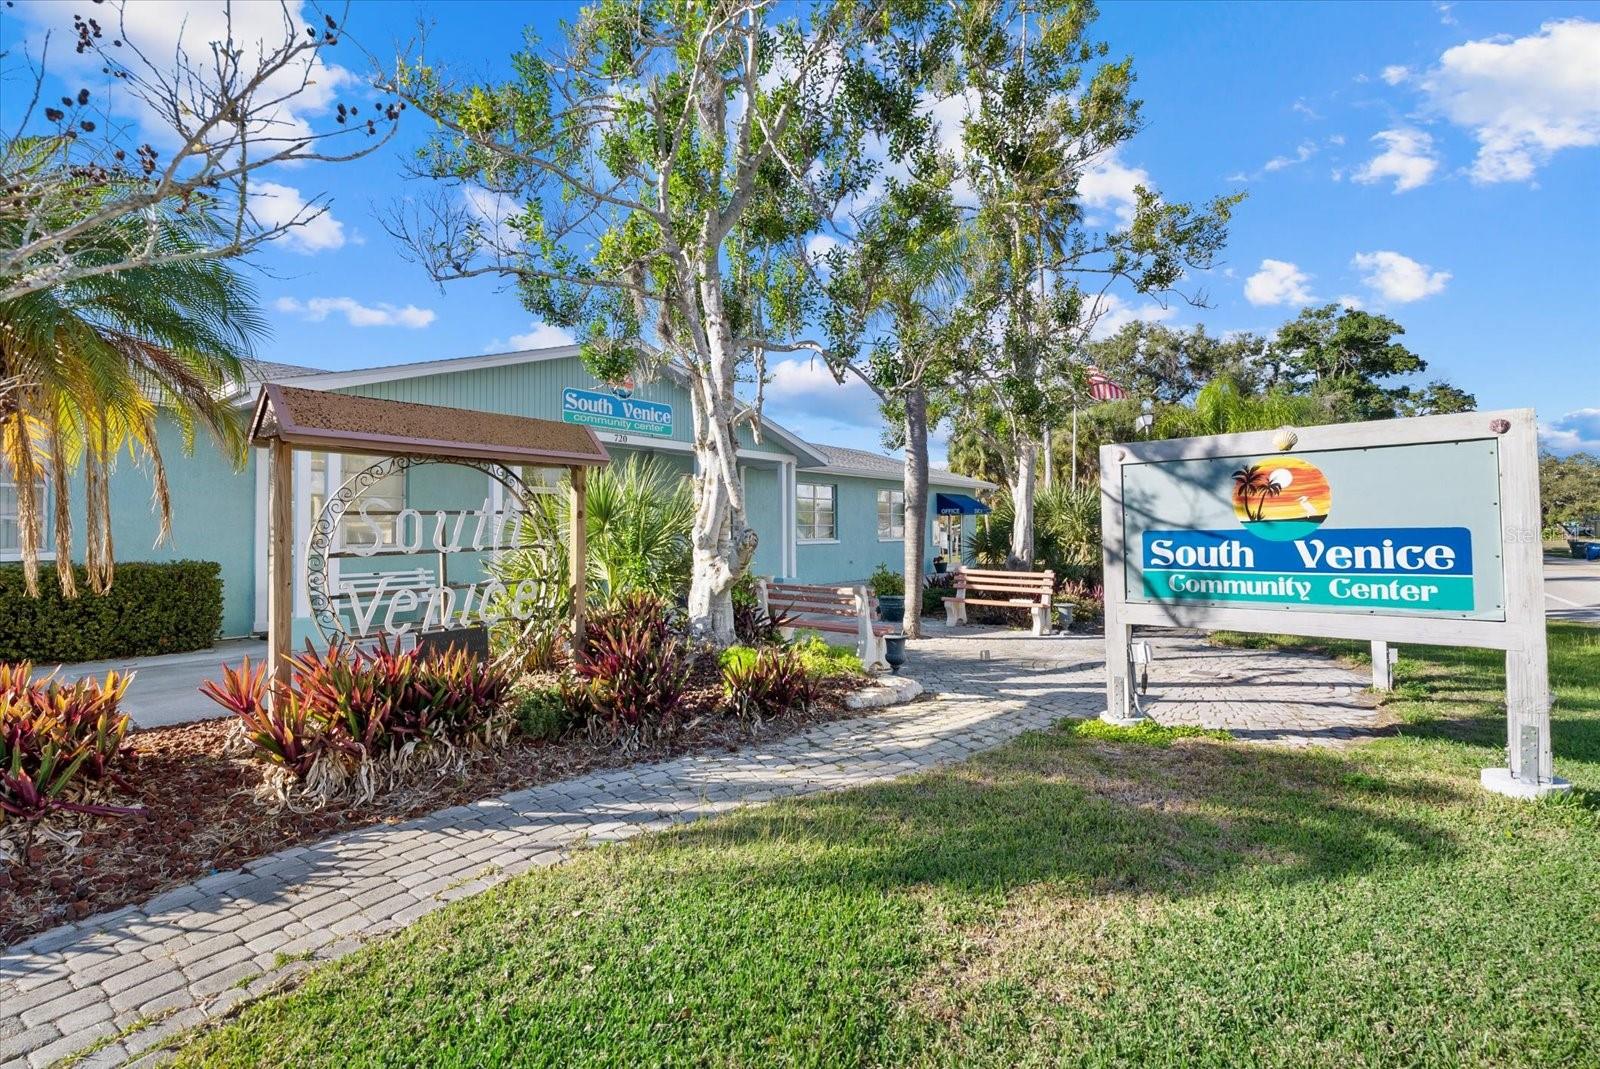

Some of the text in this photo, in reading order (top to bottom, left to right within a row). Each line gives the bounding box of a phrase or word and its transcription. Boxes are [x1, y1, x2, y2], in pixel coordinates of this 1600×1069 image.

[565, 392, 672, 424] South Venice
[573, 413, 664, 432] community center
[614, 434, 628, 443] 720
[350, 497, 523, 557] South
[1150, 538, 1457, 571] South Venice
[1168, 574, 1440, 602] Community Center
[339, 575, 539, 638] Venice
